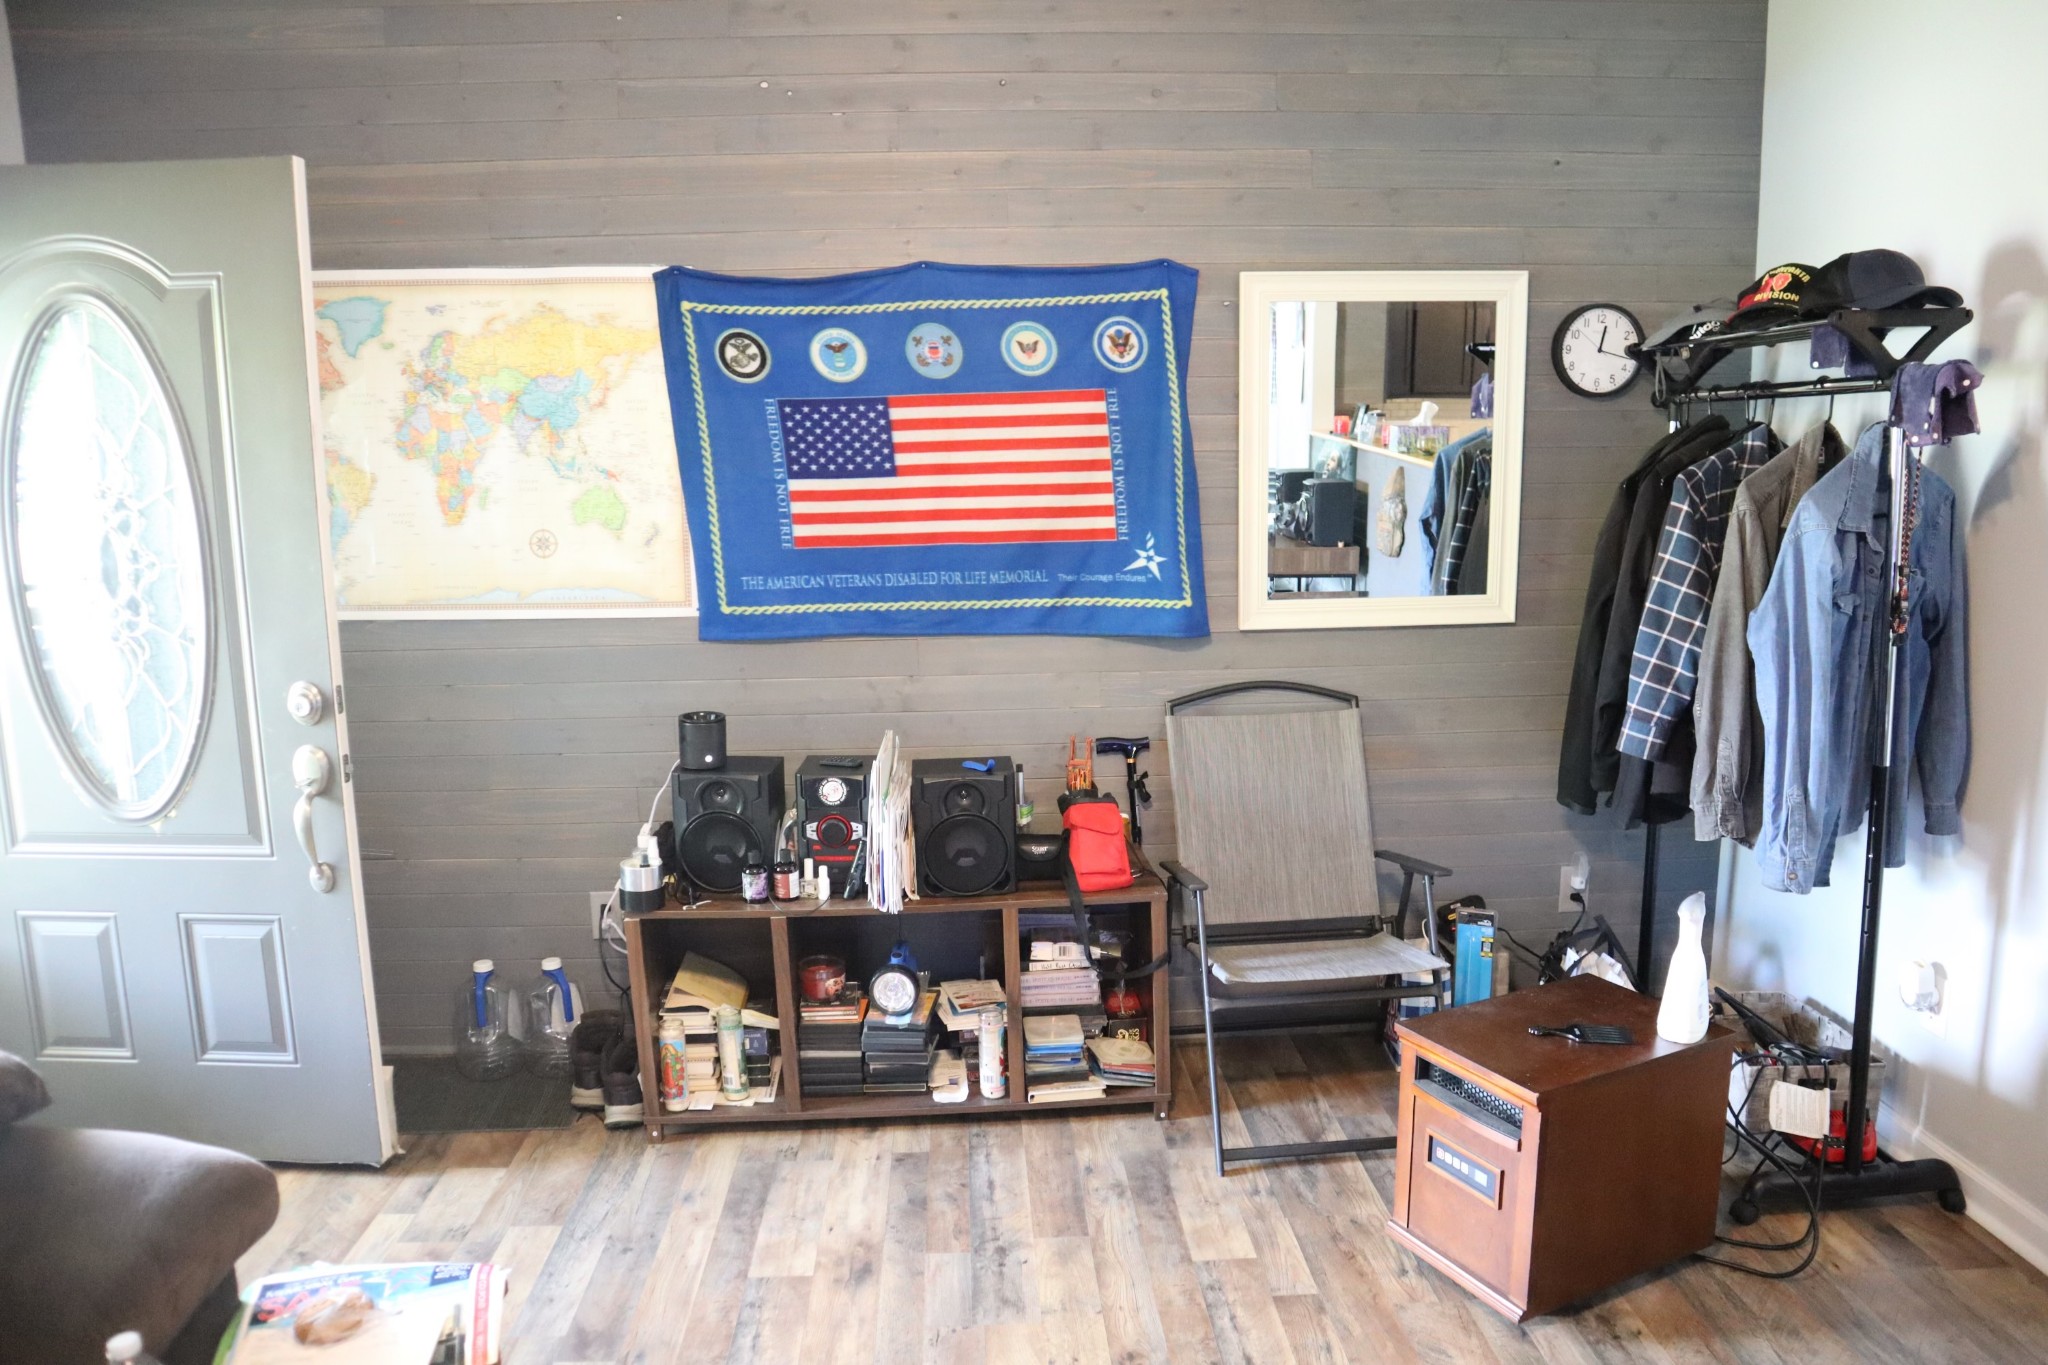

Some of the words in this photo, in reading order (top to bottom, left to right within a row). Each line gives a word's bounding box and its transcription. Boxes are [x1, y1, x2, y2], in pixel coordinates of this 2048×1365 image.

[1583, 318, 1590, 328] 11
[1597, 313, 1607, 324] 12
[1571, 329, 1580, 340] 10
[1624, 330, 1630, 341] 2
[1565, 344, 1572, 354] 9
[1568, 361, 1575, 371] 8
[1621, 363, 1627, 372] 4
[1579, 372, 1586, 382] 7
[1593, 377, 1600, 388] 6
[1609, 374, 1616, 384] 5
[1107, 388, 1119, 419] FREE
[764, 398, 783, 463] FREEDOM
[1111, 426, 1123, 454] NOT
[1114, 458, 1124, 471] IS
[774, 468, 785, 480] IS
[776, 484, 788, 512] NOT
[1115, 476, 1128, 540] FREEDOM
[779, 519, 792, 549] FREE
[740, 576, 764, 590] THE
[766, 575, 825, 590] AMERICAN
[827, 574, 882, 588] VETERANS
[884, 571, 938, 587] DISABLED
[940, 571, 965, 585] FOR
[965, 571, 987, 585] LIFE
[989, 569, 1049, 584] MEMORIAL
[1057, 573, 1078, 582] Their
[1079, 573, 1113, 582] Courage
